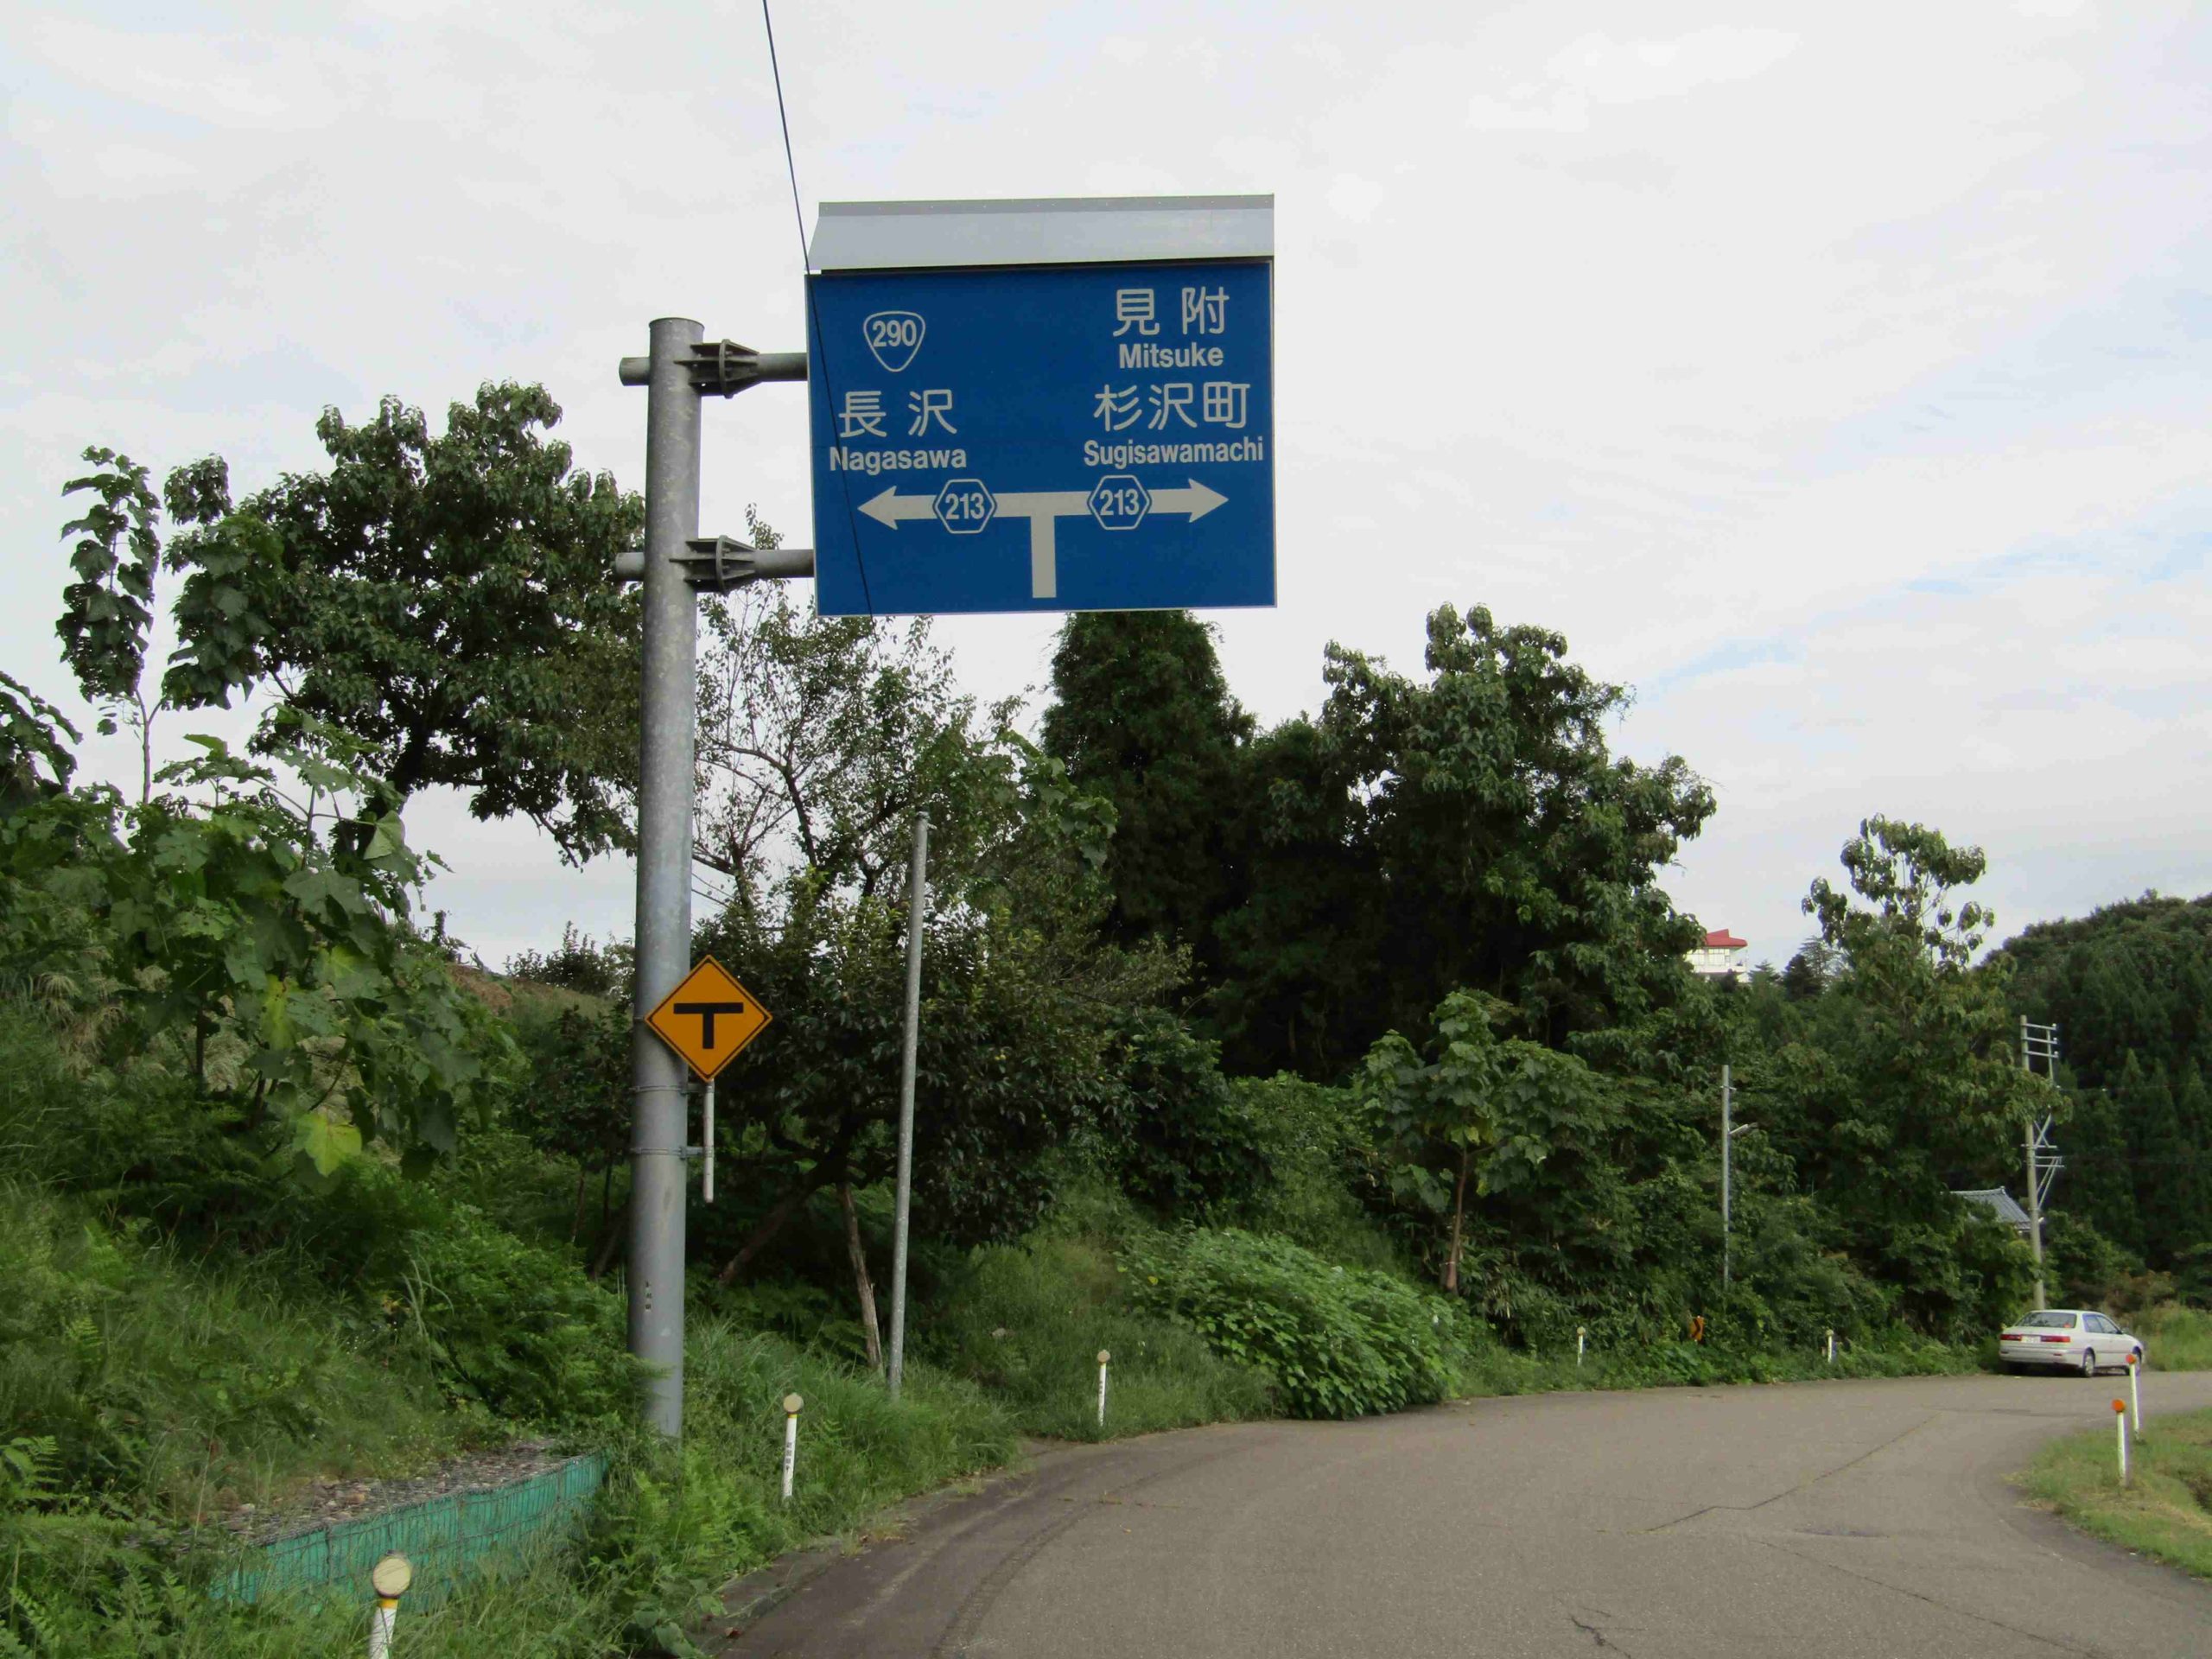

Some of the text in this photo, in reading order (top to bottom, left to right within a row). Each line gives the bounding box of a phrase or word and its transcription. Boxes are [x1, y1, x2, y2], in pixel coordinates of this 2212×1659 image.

[1113, 287, 1229, 336] 見附
[871, 319, 918, 347] 290
[1119, 342, 1224, 369] Mitsuke
[839, 389, 957, 438] 長沢
[1094, 381, 1251, 432] 杉沢町
[830, 447, 967, 475] Nagasawa
[1084, 436, 1263, 469] Sugisawamachi
[944, 493, 985, 520] 213
[1098, 488, 1141, 517] 213
